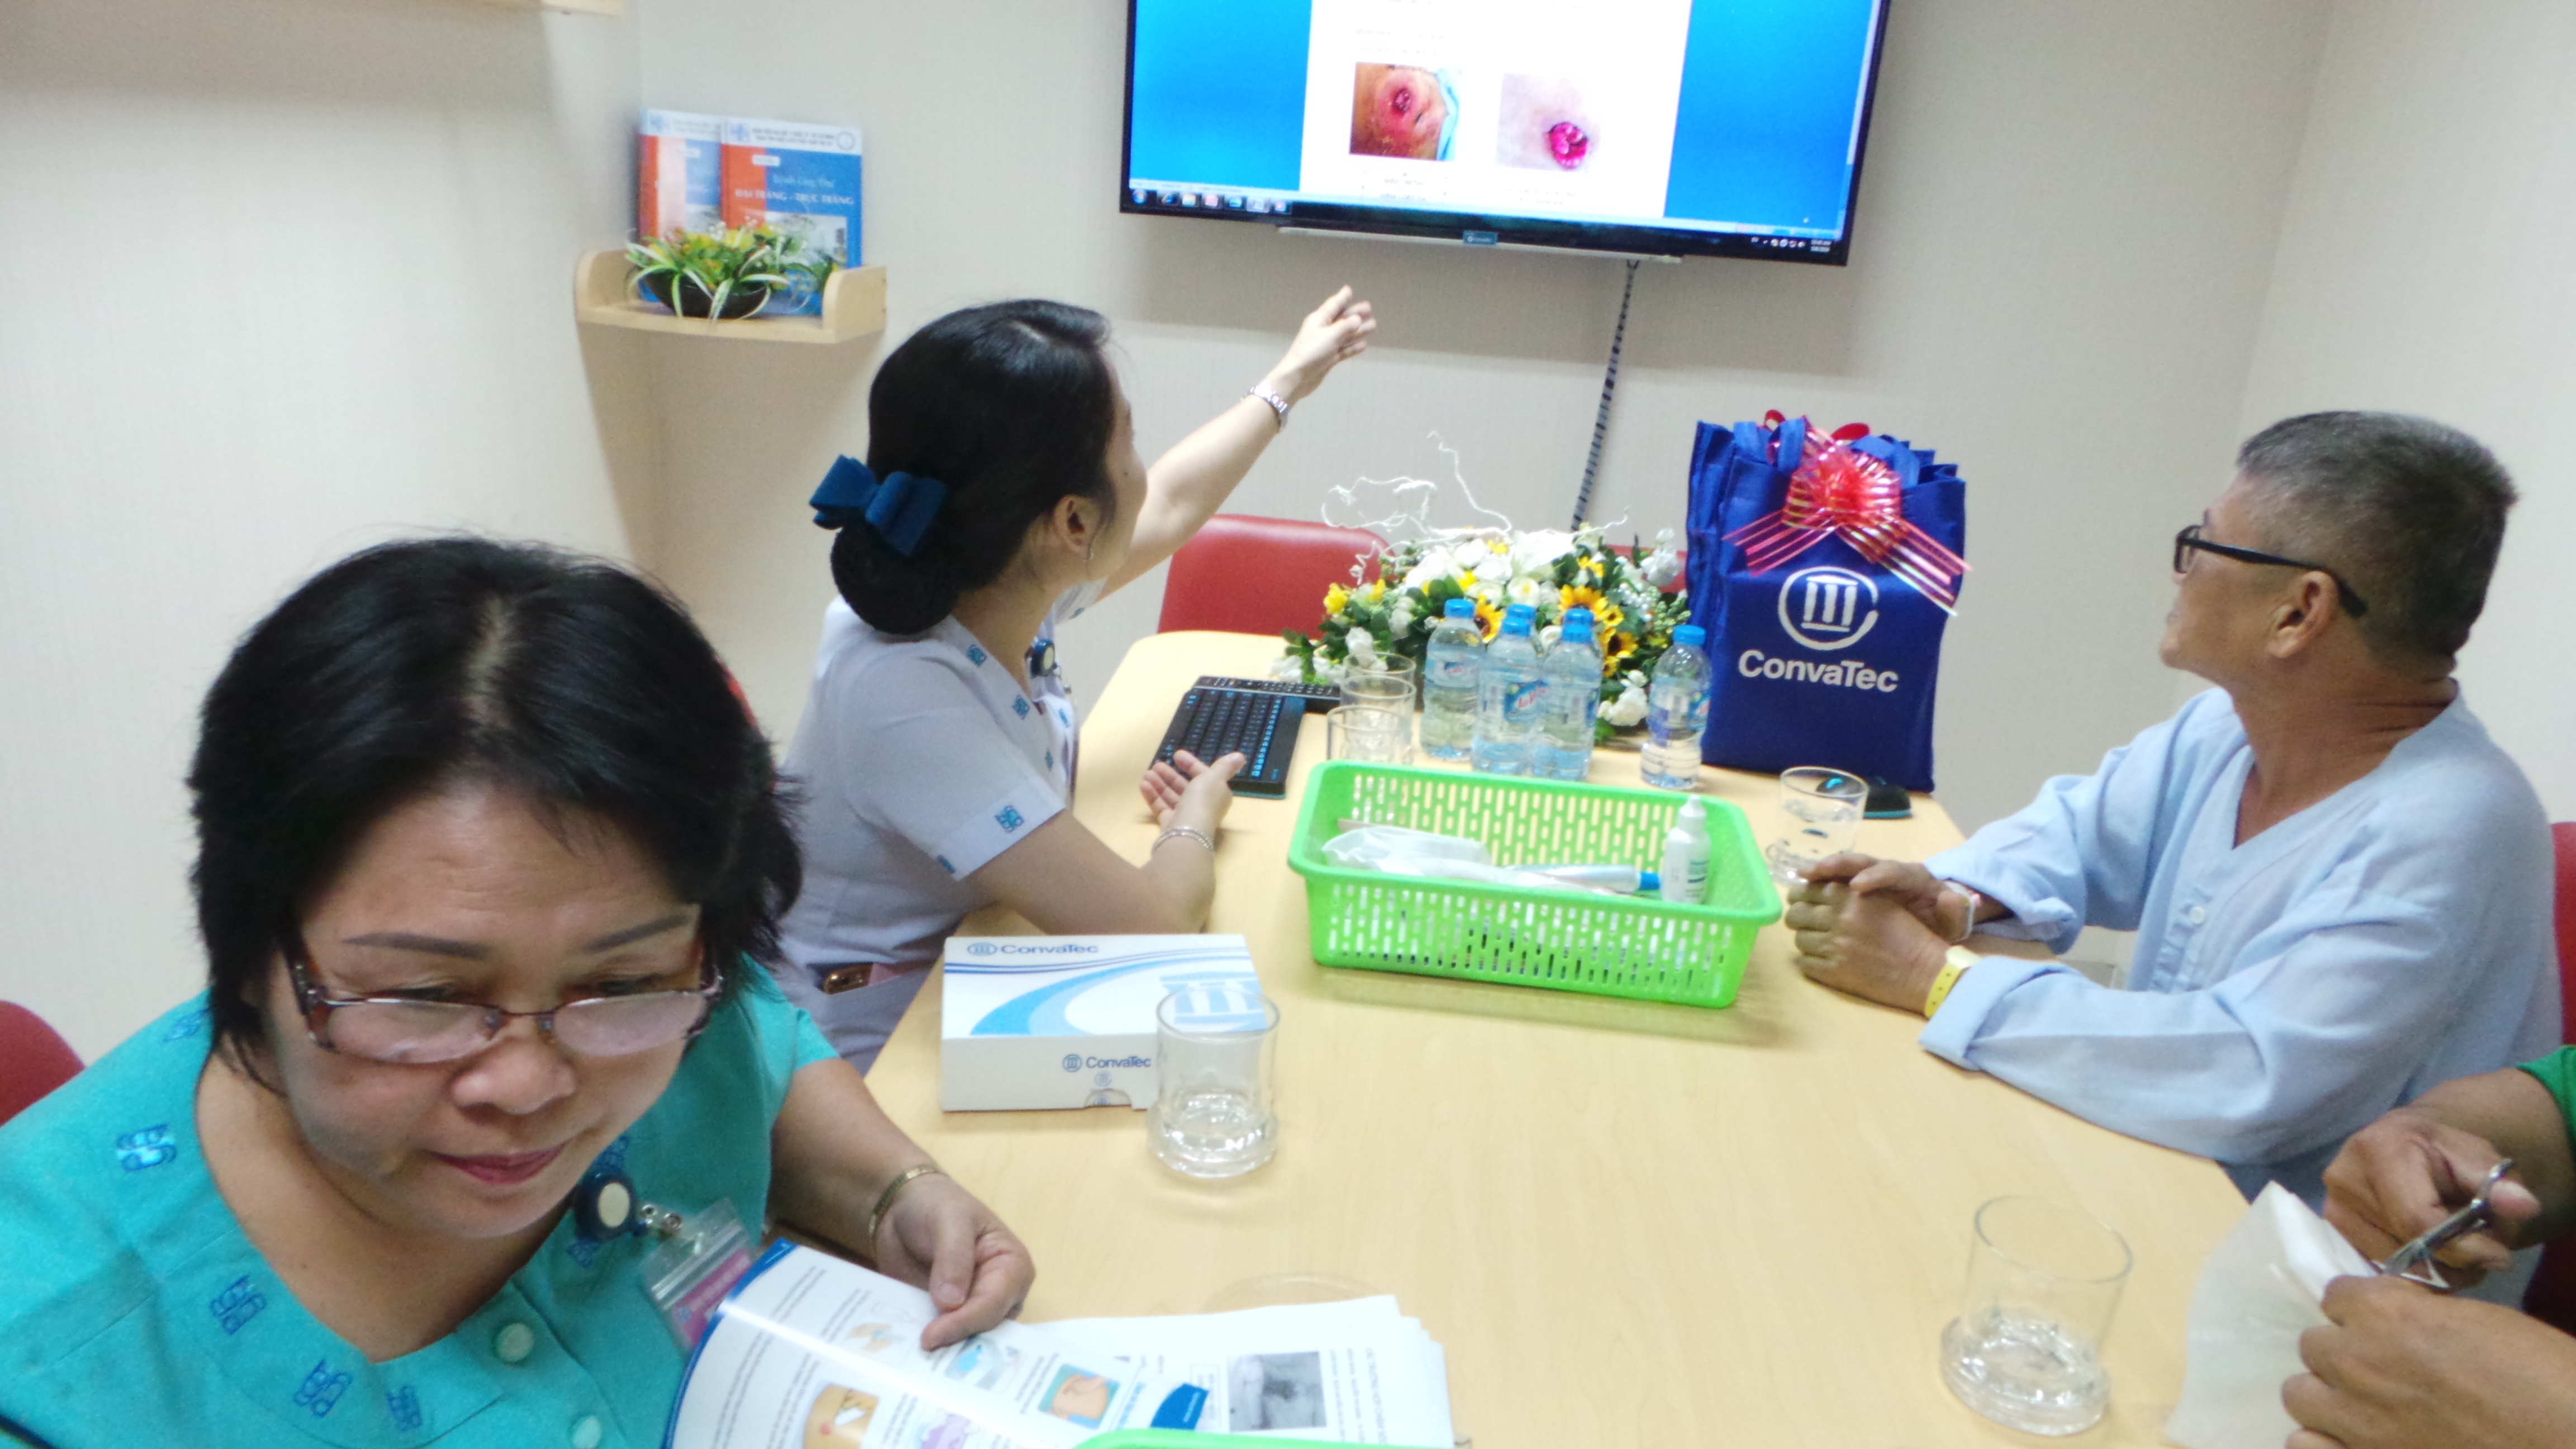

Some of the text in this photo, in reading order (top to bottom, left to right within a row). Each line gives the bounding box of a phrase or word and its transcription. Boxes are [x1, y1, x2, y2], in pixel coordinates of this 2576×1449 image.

[1739, 649, 1898, 692] ConvaTec
[1001, 944, 1098, 954] ConvaTec
[1086, 1055, 1152, 1068] ConvaTec
